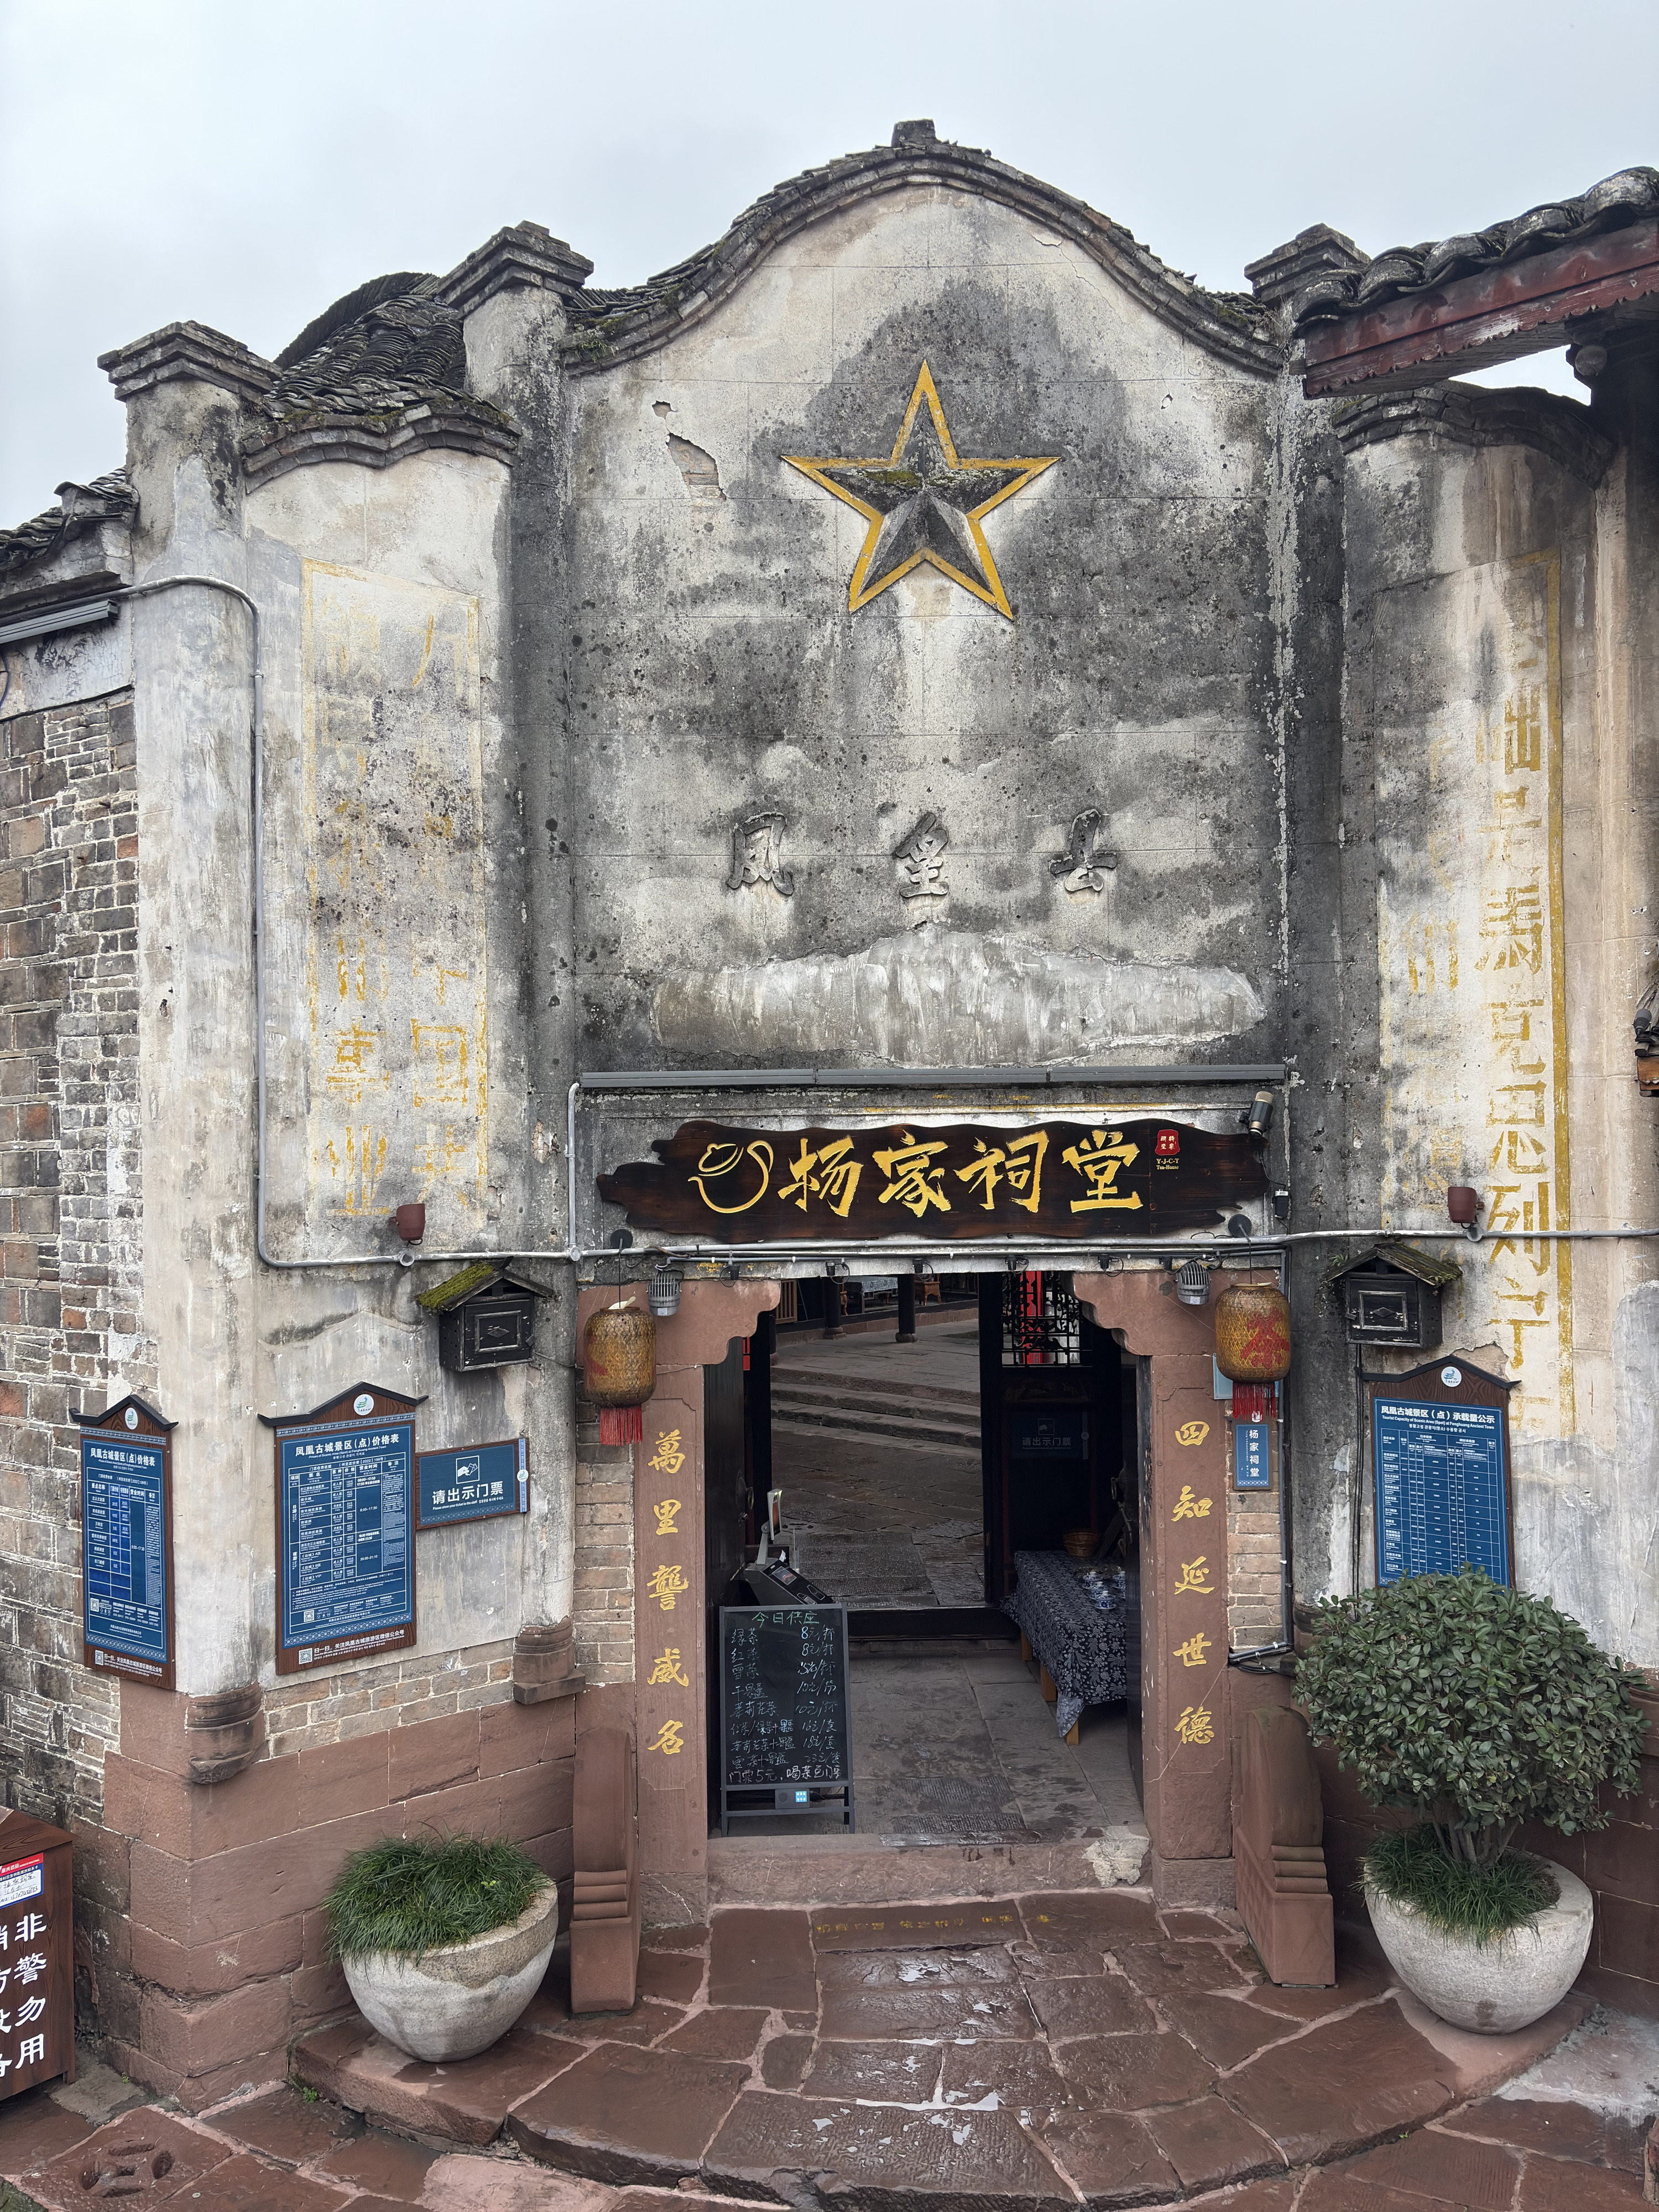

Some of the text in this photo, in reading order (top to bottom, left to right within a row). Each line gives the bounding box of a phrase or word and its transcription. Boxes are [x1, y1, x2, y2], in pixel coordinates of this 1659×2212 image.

[776, 1128, 1144, 1218] 杨家祠堂
[1022, 1437, 1071, 1446] 请出示门票
[1249, 1430, 1260, 1477] 杨家祠堂
[432, 1480, 503, 1505] 请出示门票
[1171, 1421, 1215, 1745] 四知延世德
[752, 1610, 820, 1628] 今日供应
[14, 1913, 47, 2069] 非警勿用
